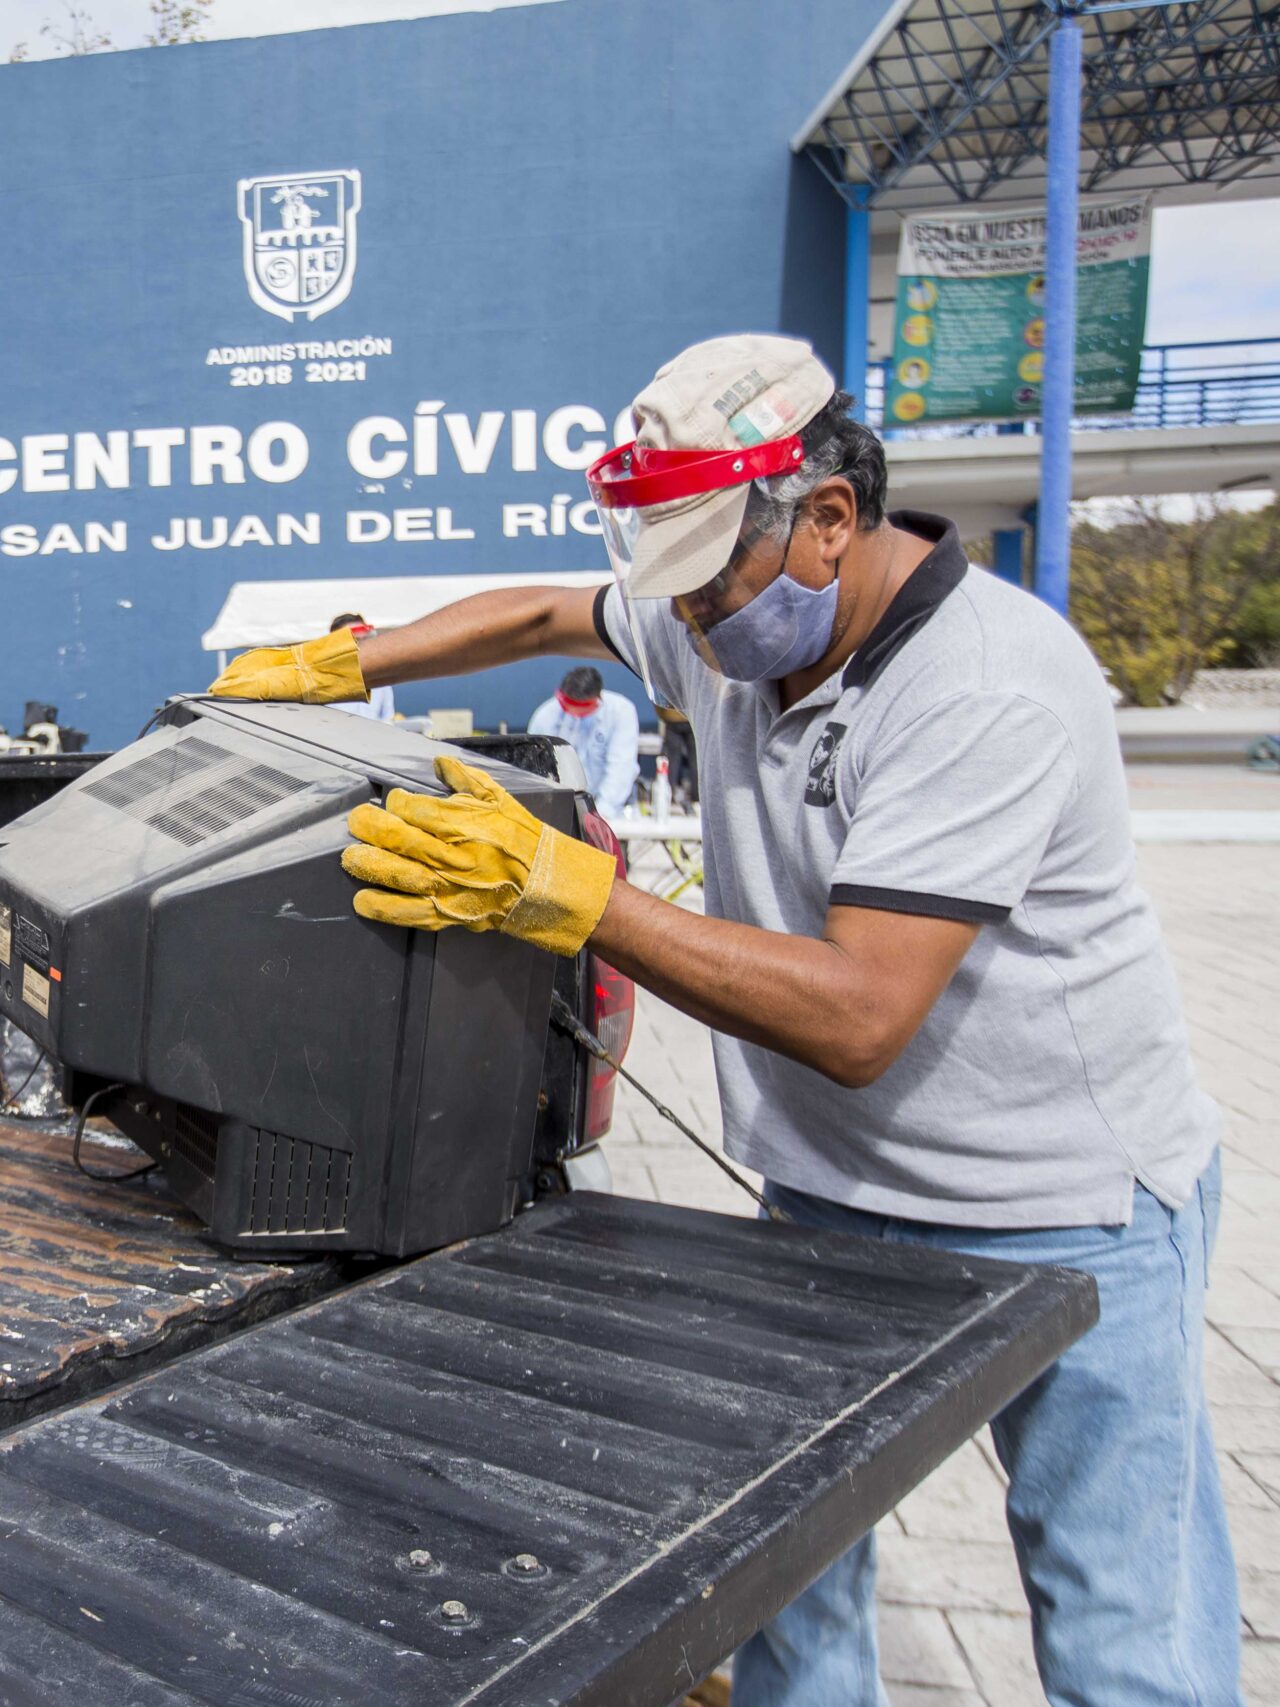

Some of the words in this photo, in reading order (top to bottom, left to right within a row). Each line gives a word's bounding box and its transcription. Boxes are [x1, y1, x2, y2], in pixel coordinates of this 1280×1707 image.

[206, 335, 392, 365] ADMINISTRACIÓN
[230, 364, 292, 386] 2018
[305, 360, 367, 382] 2021
[1, 521, 128, 557] SAN
[151, 513, 320, 551] JUAN
[347, 507, 476, 543] DEL
